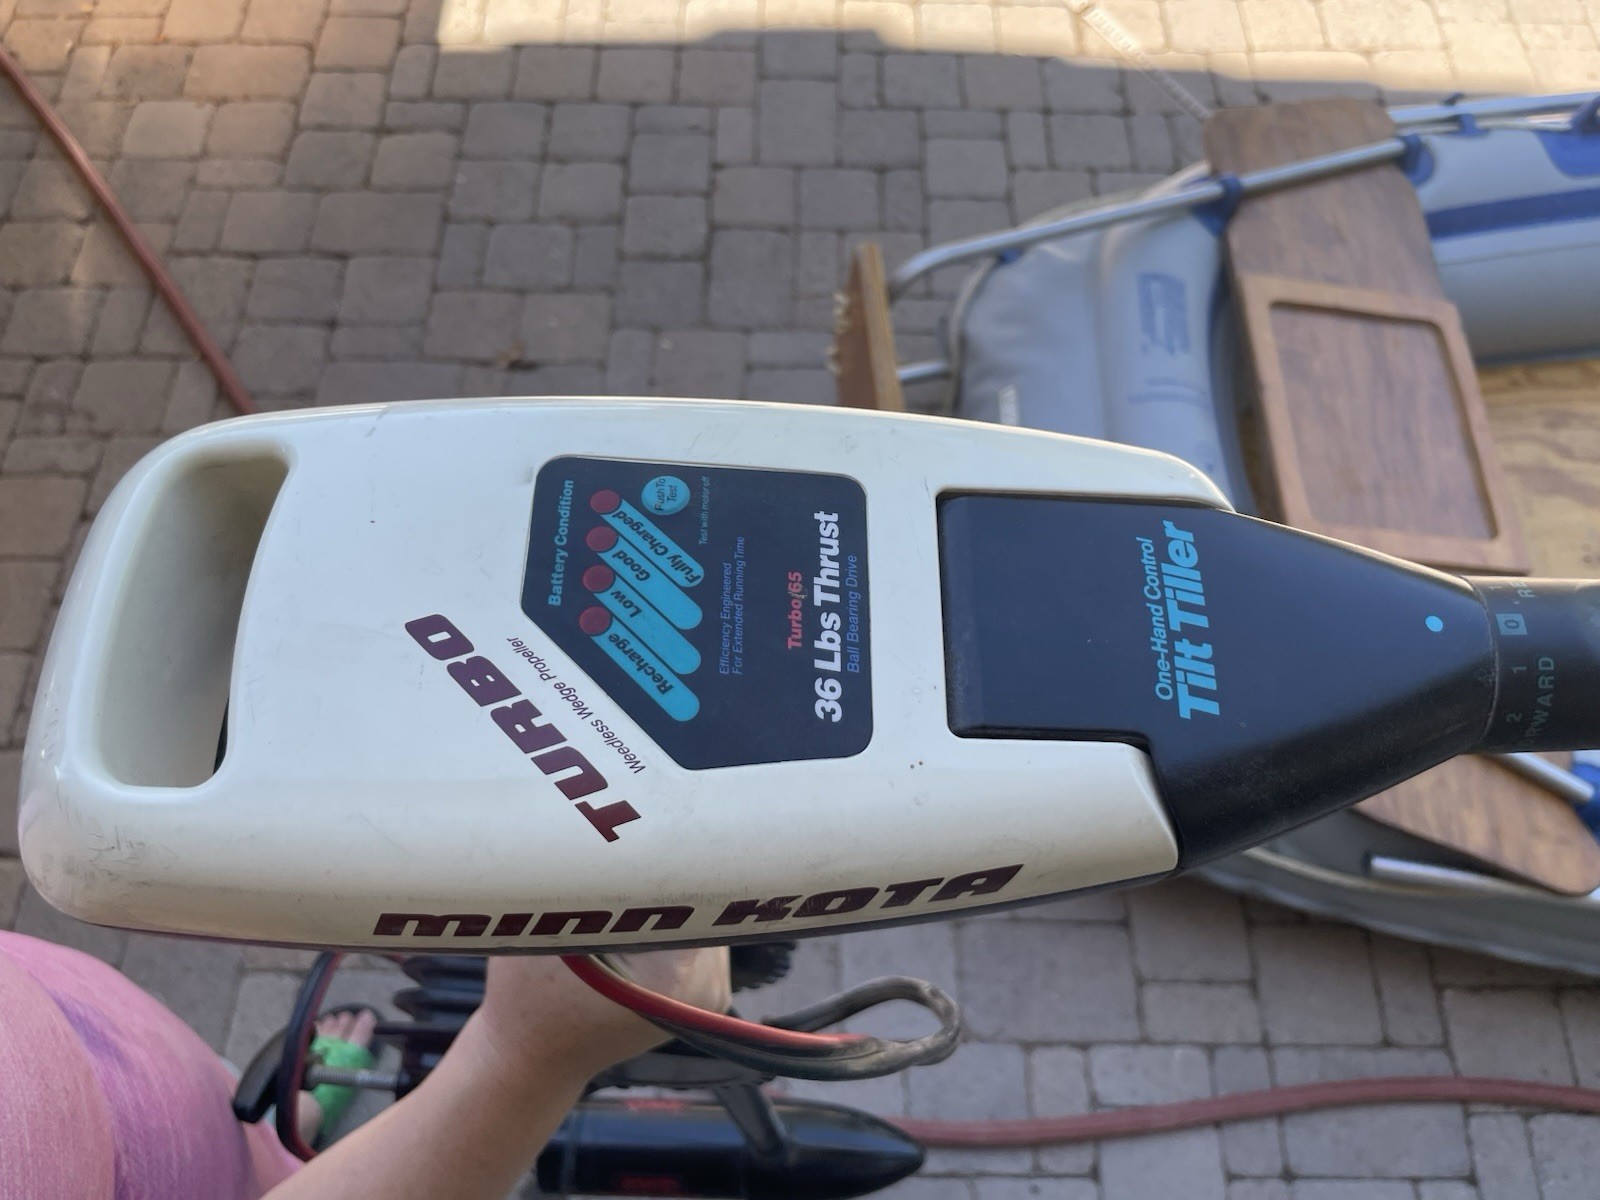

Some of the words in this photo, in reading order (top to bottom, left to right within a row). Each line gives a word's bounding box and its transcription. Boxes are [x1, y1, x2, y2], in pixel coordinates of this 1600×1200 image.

[654, 489, 665, 511] Push
[656, 478, 666, 488] To
[667, 485, 678, 502] Test
[701, 489, 709, 509] motor
[554, 480, 574, 546] Condition
[612, 510, 669, 556] Charged
[699, 528, 708, 545] Test
[700, 510, 709, 526] with
[612, 550, 651, 582] Good
[667, 554, 701, 584] Fully
[734, 536, 745, 559] Time
[814, 510, 841, 606] Thrust
[845, 555, 858, 587] Drive
[1136, 536, 1162, 600] Control
[548, 551, 569, 606] Battery
[720, 562, 733, 620] Engineered
[734, 560, 746, 602] Running
[1161, 520, 1209, 632] Tiller
[610, 590, 642, 618] Low
[733, 603, 744, 653] Extended
[787, 598, 802, 649] Turbo
[846, 590, 861, 642] Bearing
[506, 635, 557, 682] Propeller
[608, 633, 674, 695] Recharge
[719, 622, 733, 674] Efficiency
[732, 656, 743, 675] For
[814, 612, 842, 672] Lbs
[846, 646, 860, 673] Ball
[1145, 603, 1174, 700] One-Hand
[554, 682, 594, 720] Wedge
[814, 677, 842, 723] 36
[1174, 638, 1220, 720] Tilt
[1518, 656, 1555, 747] ORWARD
[404, 614, 642, 843] TURBO
[590, 718, 646, 774] Weedless
[711, 864, 1024, 926] KOTA
